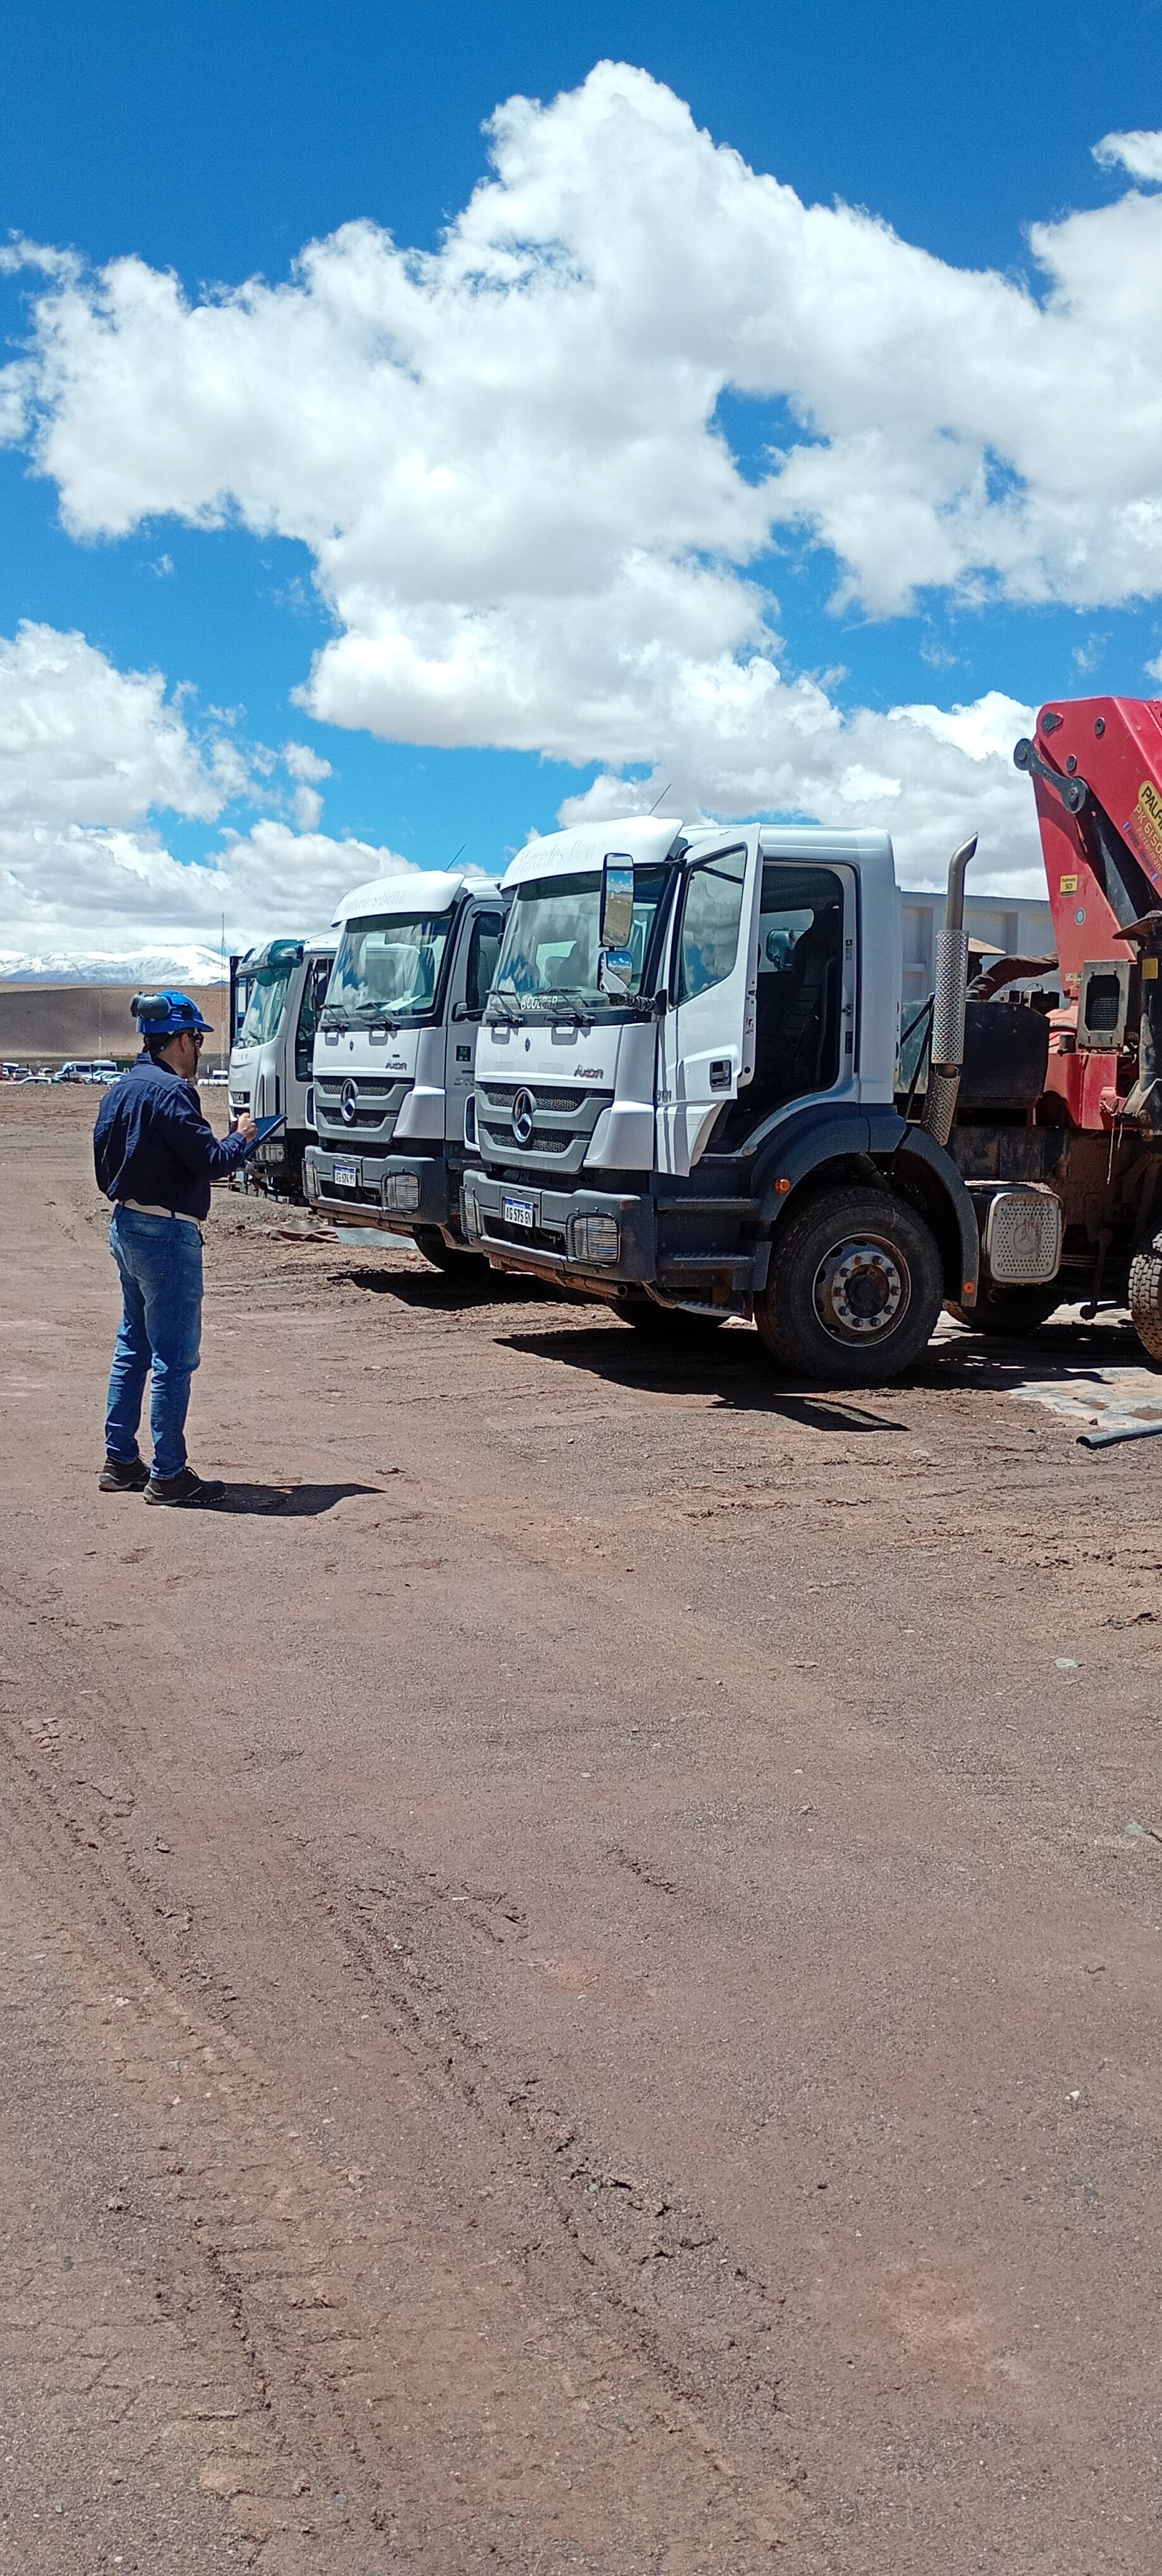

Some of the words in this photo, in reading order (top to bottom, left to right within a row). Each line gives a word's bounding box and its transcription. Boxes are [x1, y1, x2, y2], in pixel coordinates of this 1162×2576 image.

[1141, 786, 1162, 830] PALFI
[1134, 804, 1147, 824] PK
[1144, 822, 1162, 860] 6150
[506, 1206, 513, 1220] AG
[514, 1208, 524, 1223] 575
